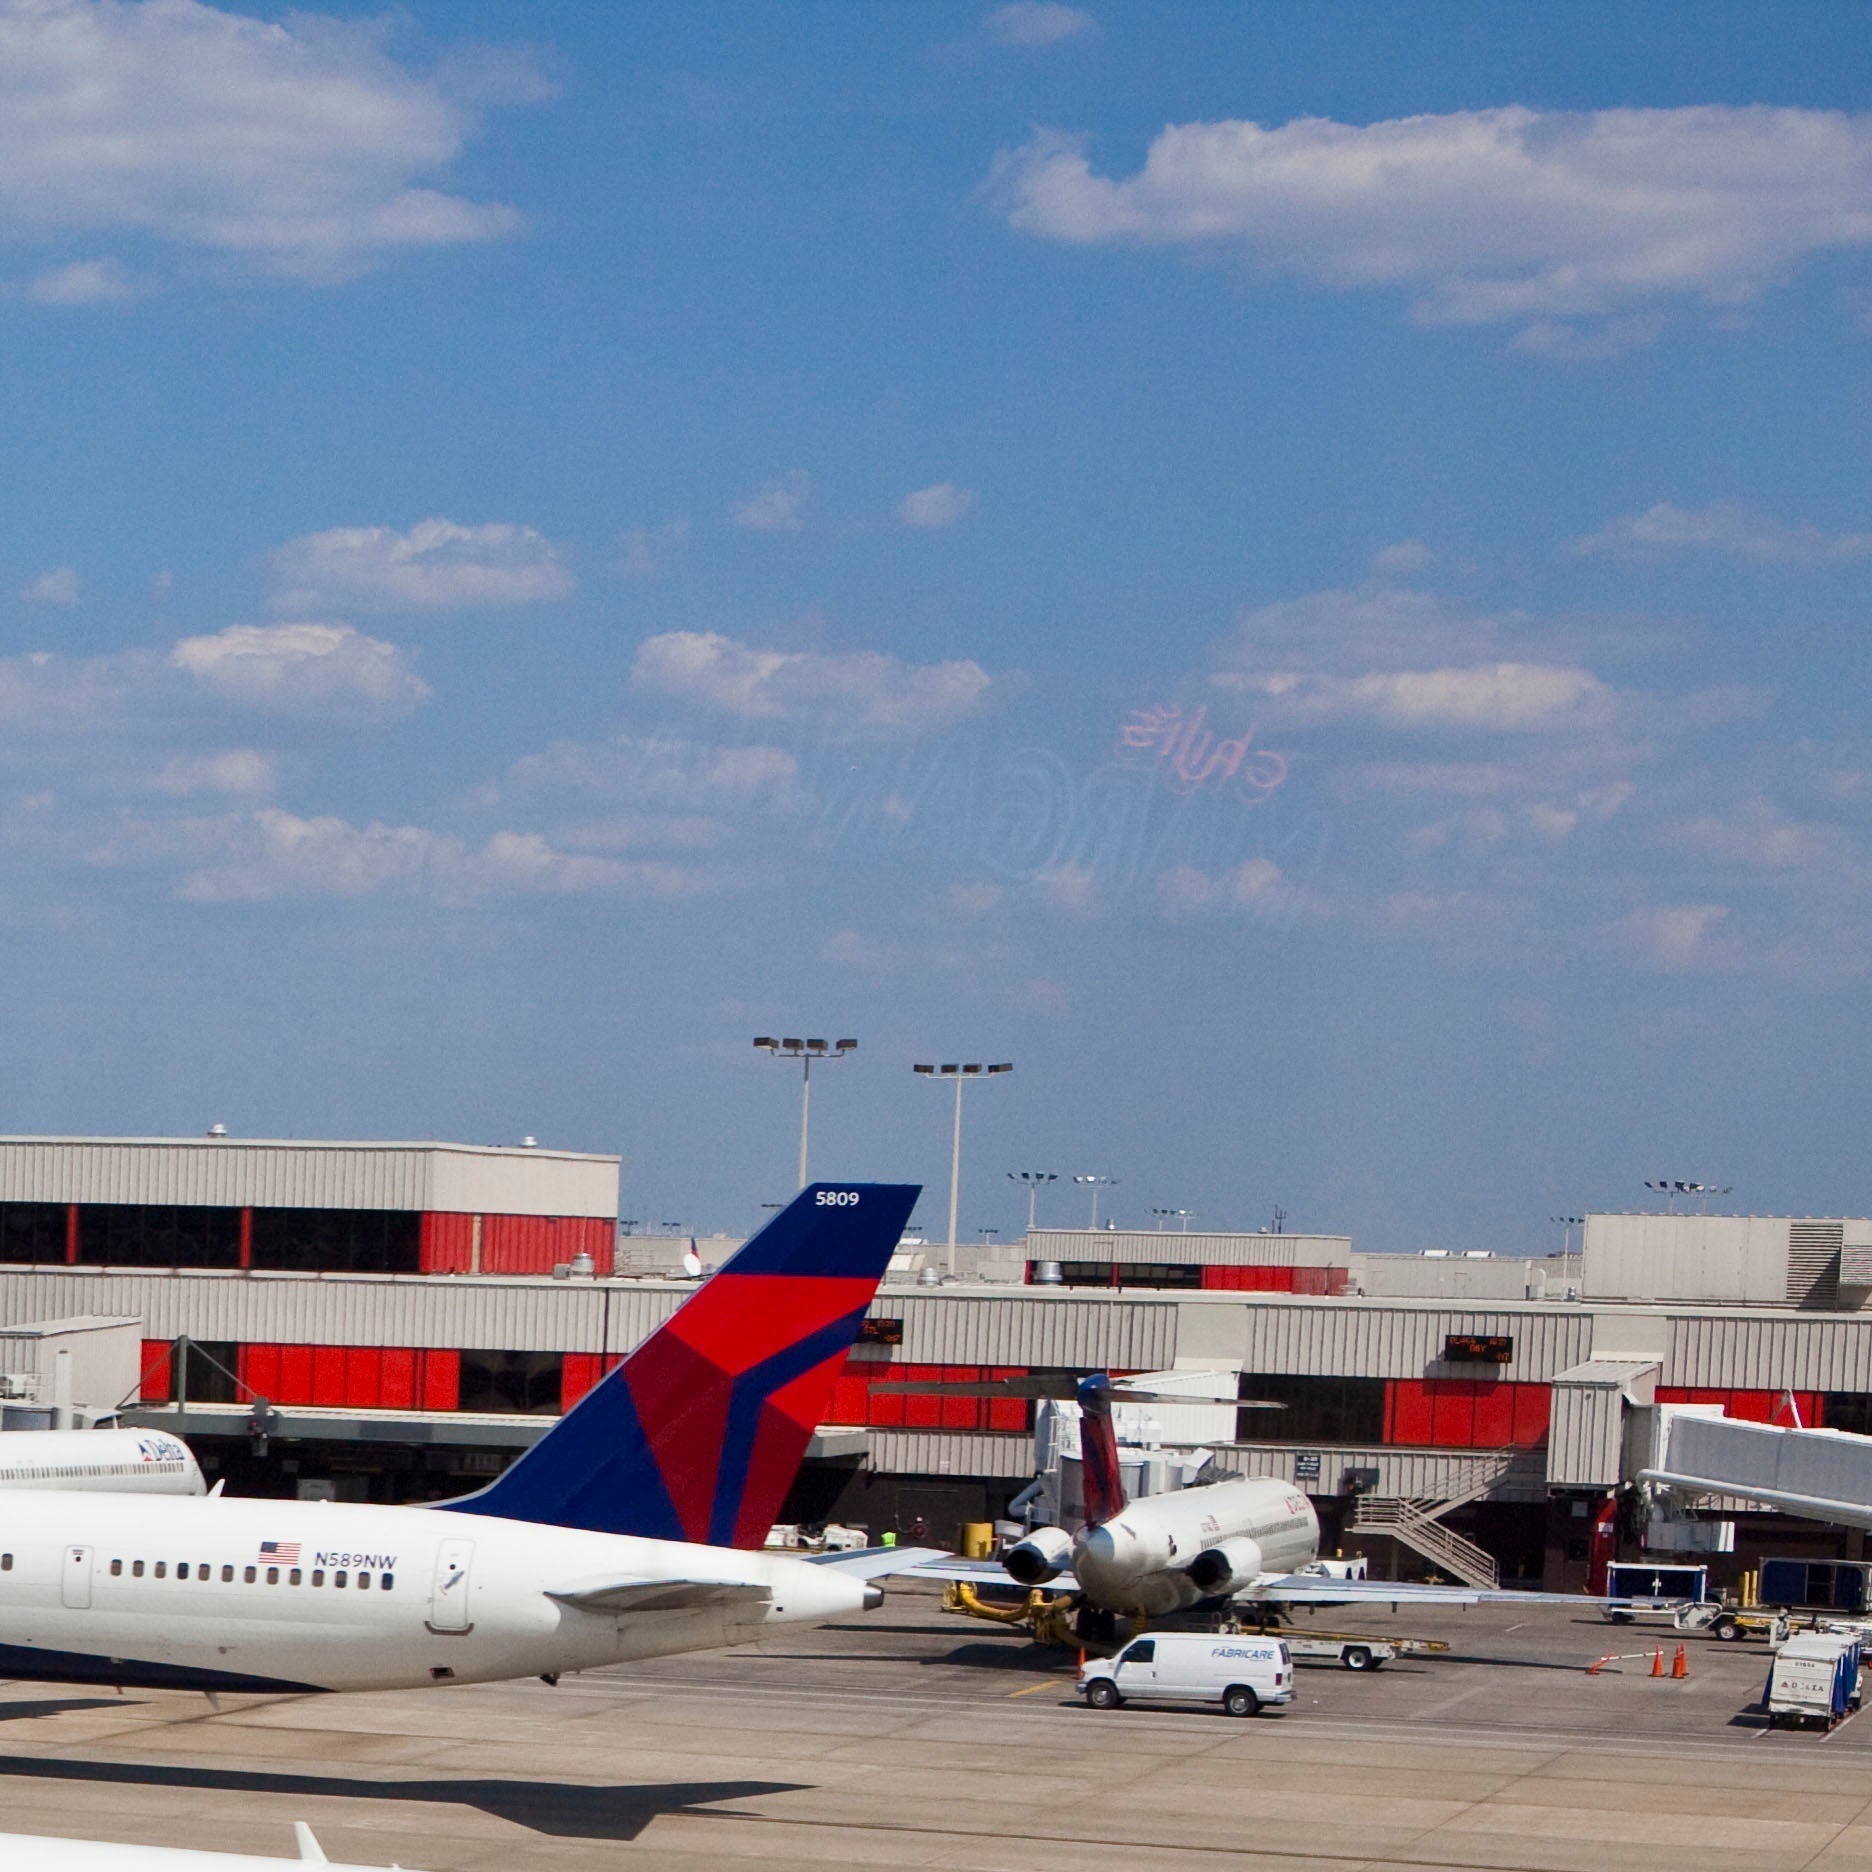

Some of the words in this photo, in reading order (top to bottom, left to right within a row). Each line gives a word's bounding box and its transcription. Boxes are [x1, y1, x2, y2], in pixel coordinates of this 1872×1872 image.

[816, 1191, 860, 1206] 5809
[315, 1552, 397, 1569] N589NW
[1211, 1648, 1275, 1660] FABRICARE
